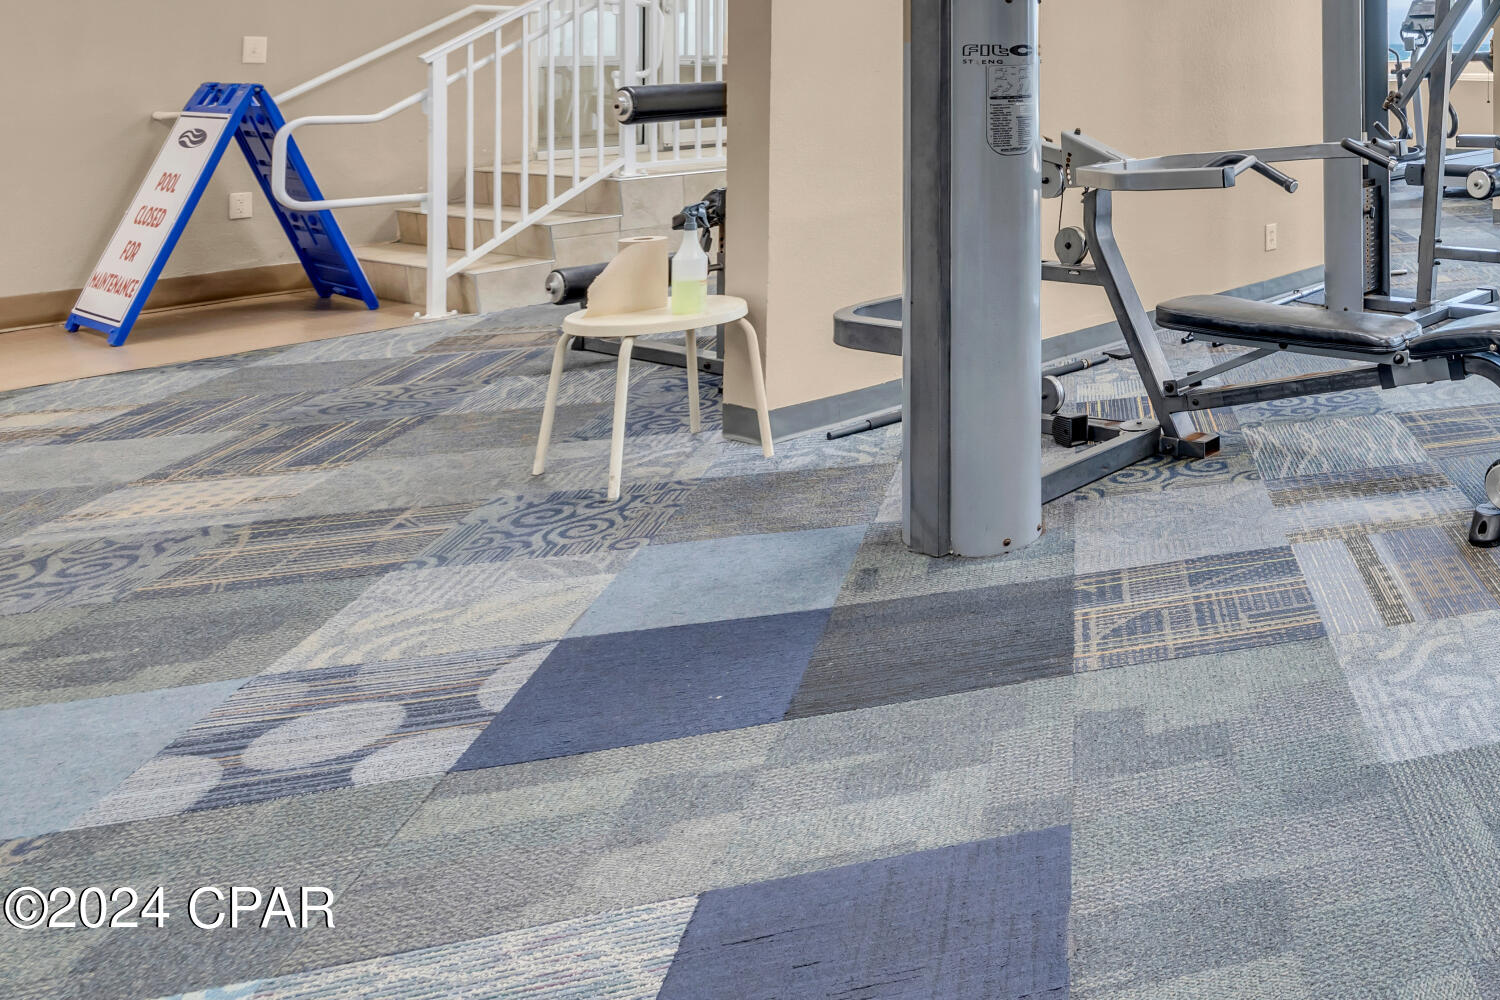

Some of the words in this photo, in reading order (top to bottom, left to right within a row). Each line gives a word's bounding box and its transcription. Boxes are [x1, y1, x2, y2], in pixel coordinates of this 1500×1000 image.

[155, 172, 181, 193] POOL
[134, 206, 167, 228] CLOSED
[120, 240, 142, 262] FOR
[88, 272, 139, 298] MAINTENANCE
